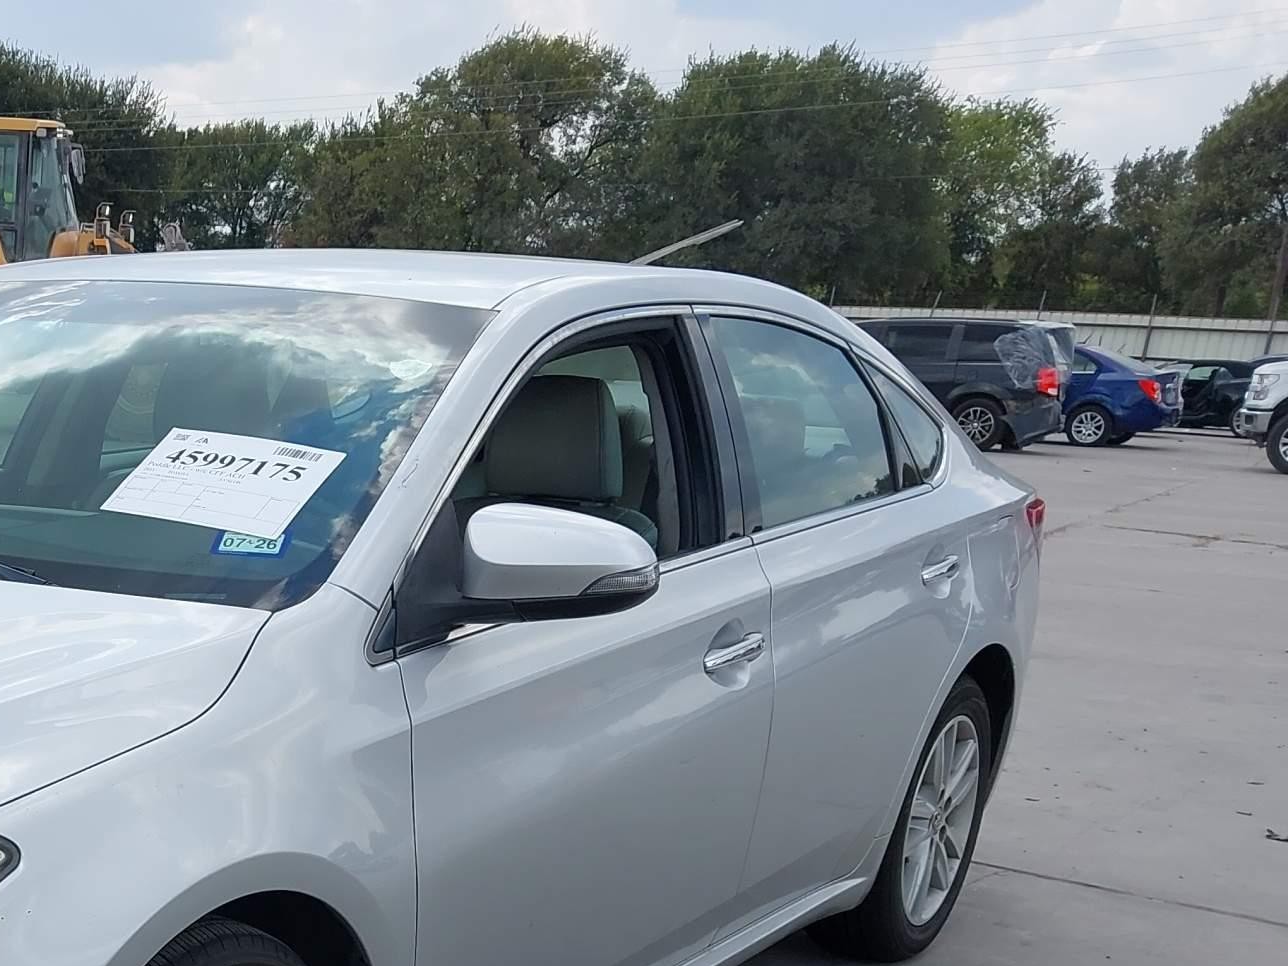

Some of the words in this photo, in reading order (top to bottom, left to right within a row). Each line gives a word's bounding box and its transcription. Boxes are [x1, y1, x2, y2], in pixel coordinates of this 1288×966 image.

[165, 448, 308, 482] 45997175
[223, 537, 247, 548] 07
[254, 538, 278, 550] 26
